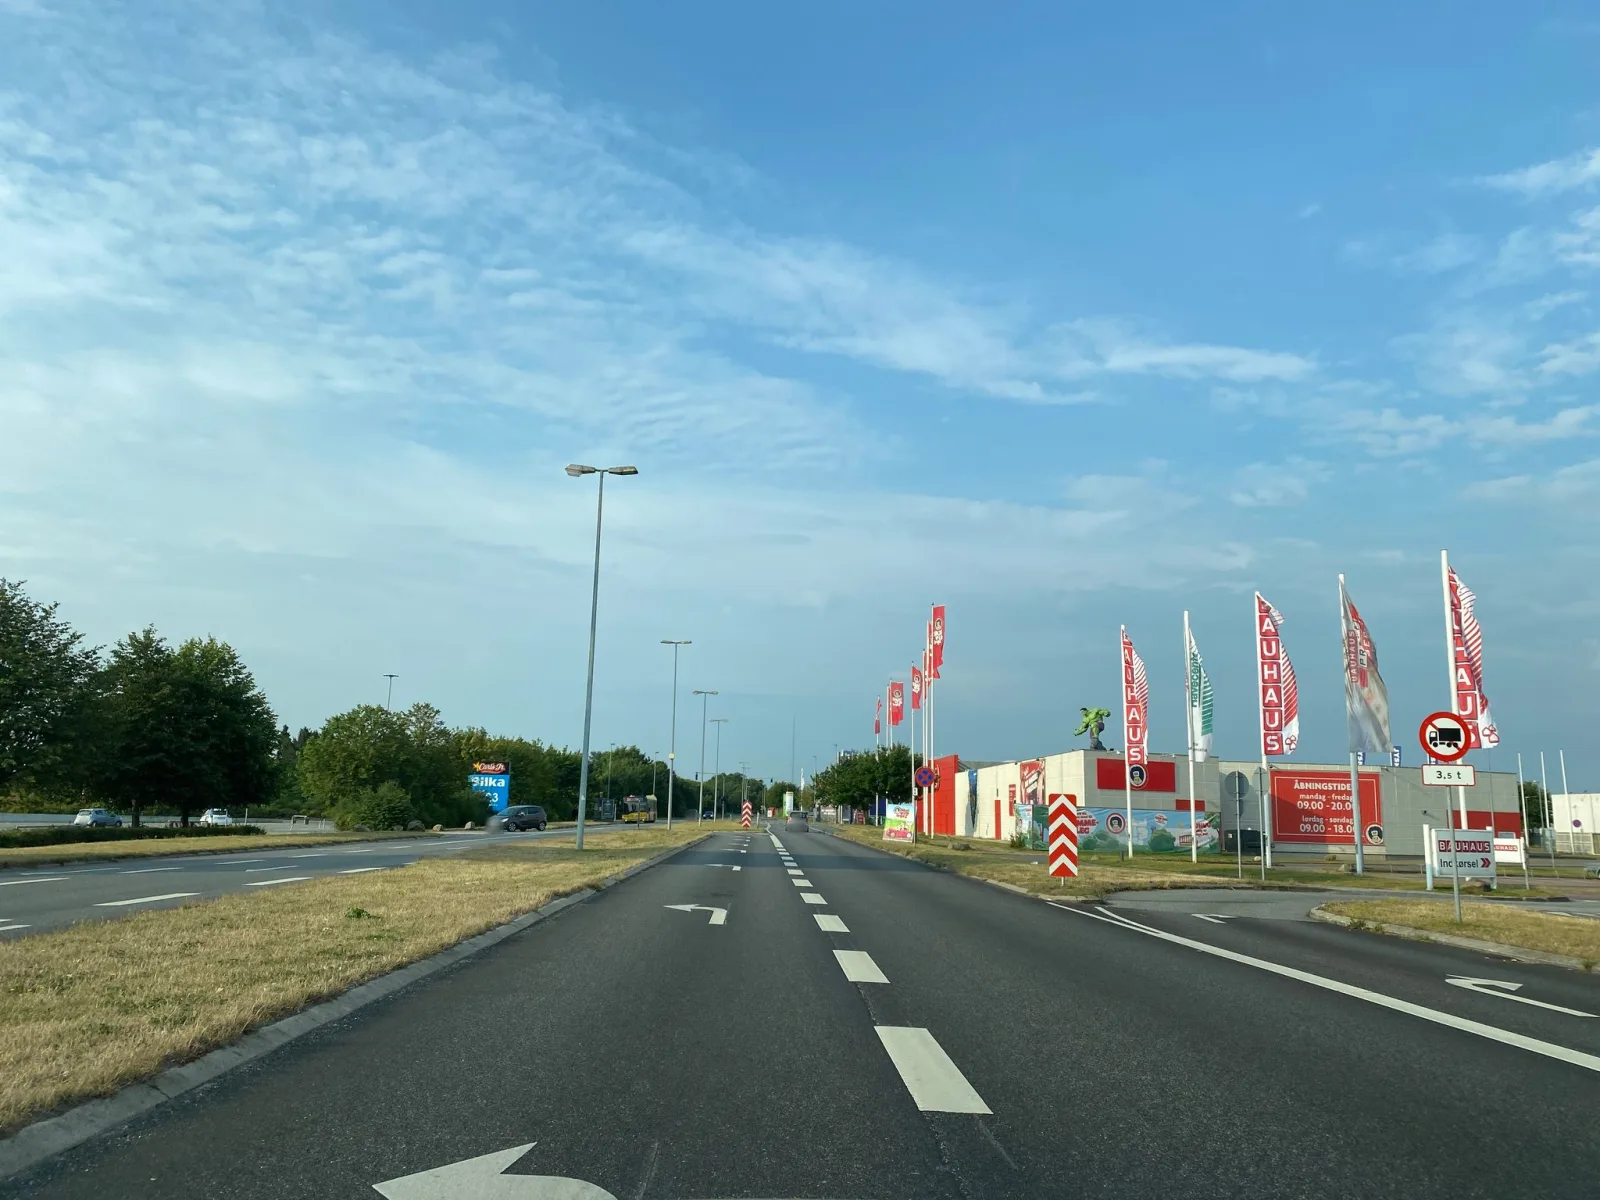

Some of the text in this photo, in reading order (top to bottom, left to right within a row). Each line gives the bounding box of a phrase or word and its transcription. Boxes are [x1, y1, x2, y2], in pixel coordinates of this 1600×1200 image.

[1456, 771, 1462, 779] t
[1294, 780, 1352, 791] ÅBNINGSTIDE
[1299, 793, 1326, 801] mandag
[1297, 801, 1324, 810] 09.00
[1331, 802, 1354, 811] 20.0
[1299, 824, 1325, 833] 09.00
